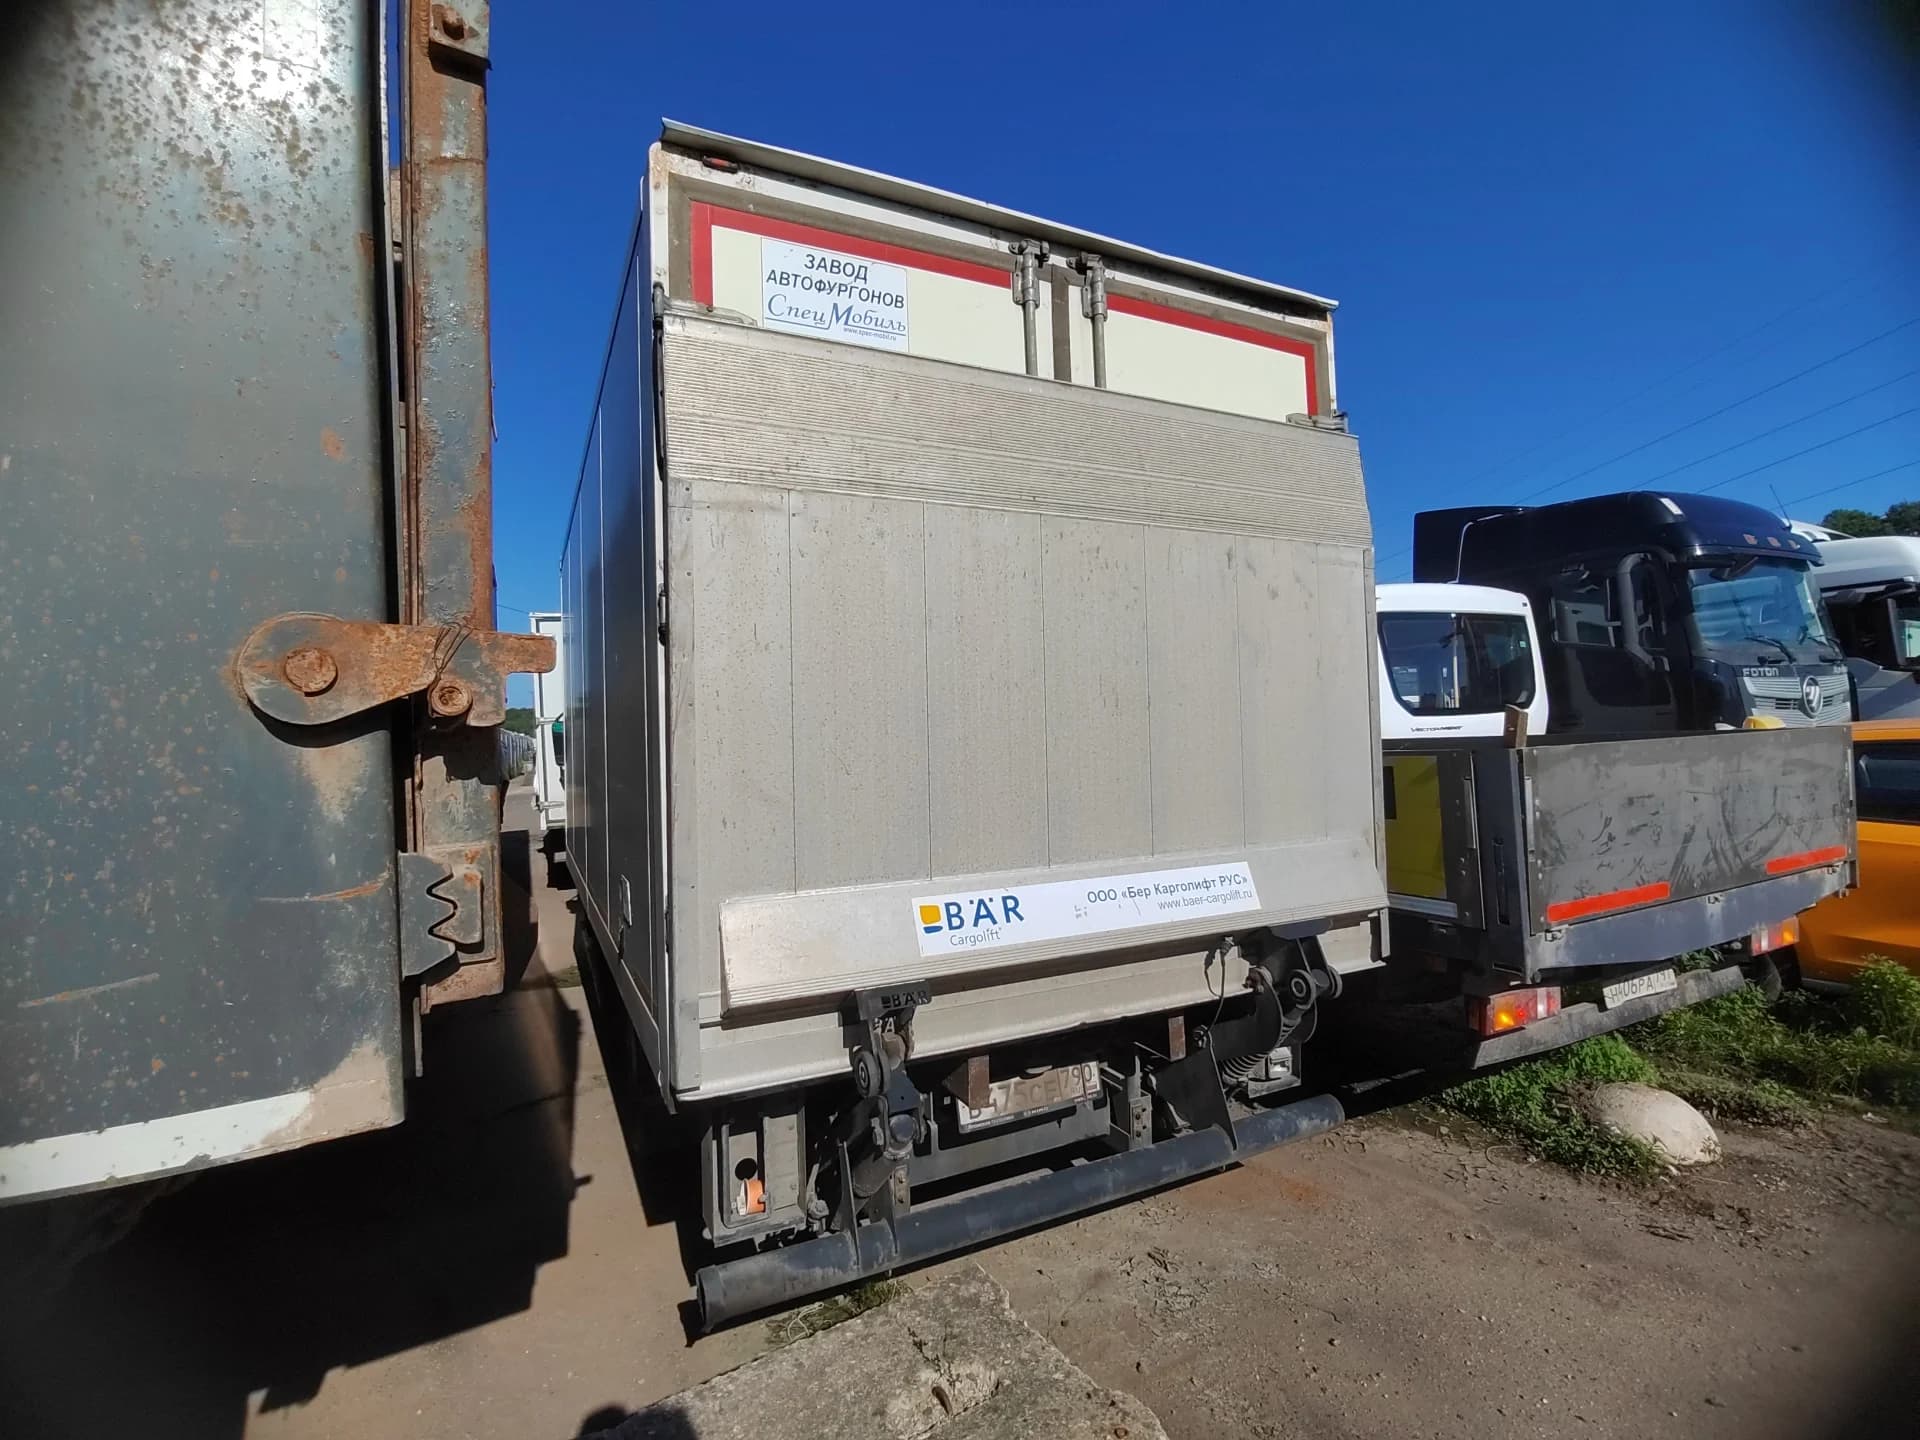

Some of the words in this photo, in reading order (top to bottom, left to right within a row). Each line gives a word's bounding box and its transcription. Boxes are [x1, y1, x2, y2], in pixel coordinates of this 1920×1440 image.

[804, 254, 868, 284] ЗАВОД
[766, 269, 905, 309] АВТОФУРГОНОВ
[1087, 889, 1118, 904] ООО
[1122, 883, 1151, 900] «Бер
[1154, 877, 1217, 897] Карголифт
[1218, 874, 1248, 888] РУС»
[1158, 889, 1253, 912] www.baer-cargolift.ru
[944, 895, 1025, 932] BÄR
[950, 927, 1001, 947] Cargolift
